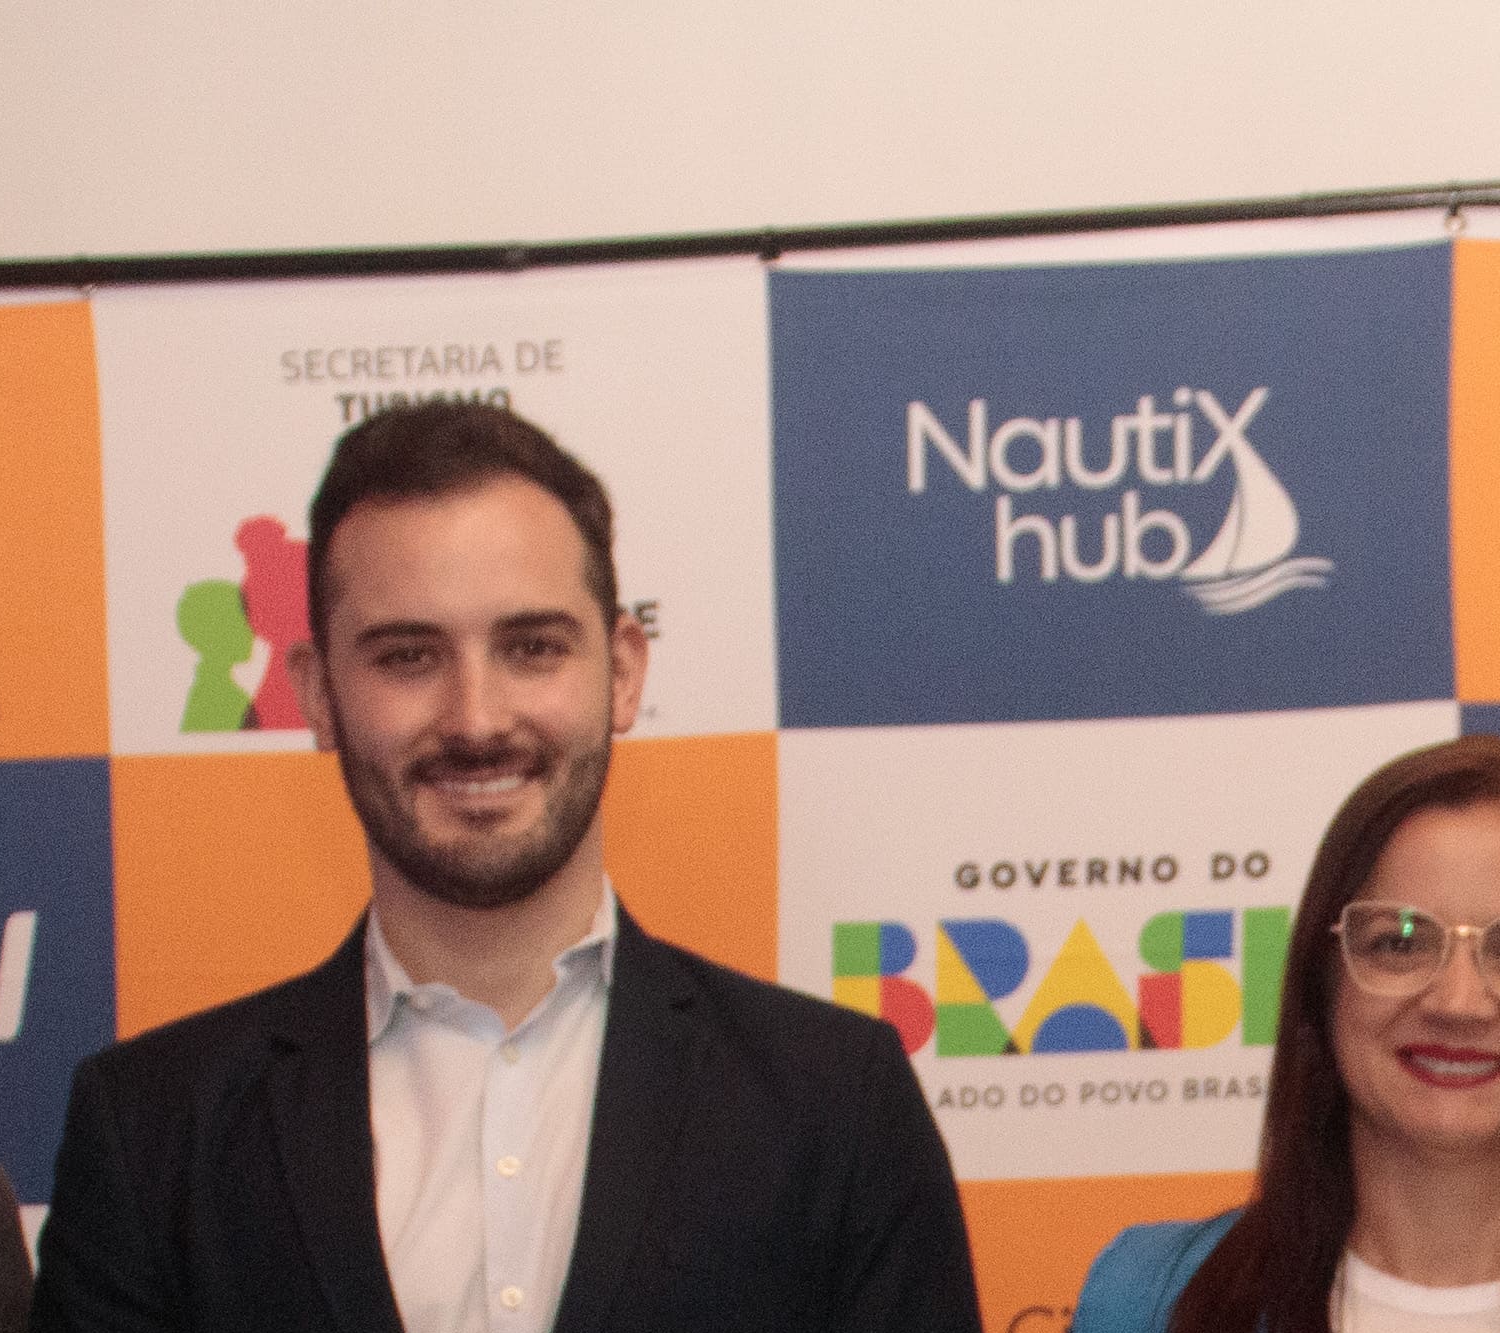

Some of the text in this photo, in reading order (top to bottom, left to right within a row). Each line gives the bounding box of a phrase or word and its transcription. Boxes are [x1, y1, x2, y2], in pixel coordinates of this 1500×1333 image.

[280, 339, 565, 384] SECRETARIA DE
[908, 386, 1269, 493] NautiX
[998, 491, 1191, 582] hub
[955, 850, 1272, 889] GOVERNO DO
[937, 1084, 1006, 1109] ADO
[1019, 1082, 1066, 1106] DO
[1079, 1078, 1169, 1105] POVO
